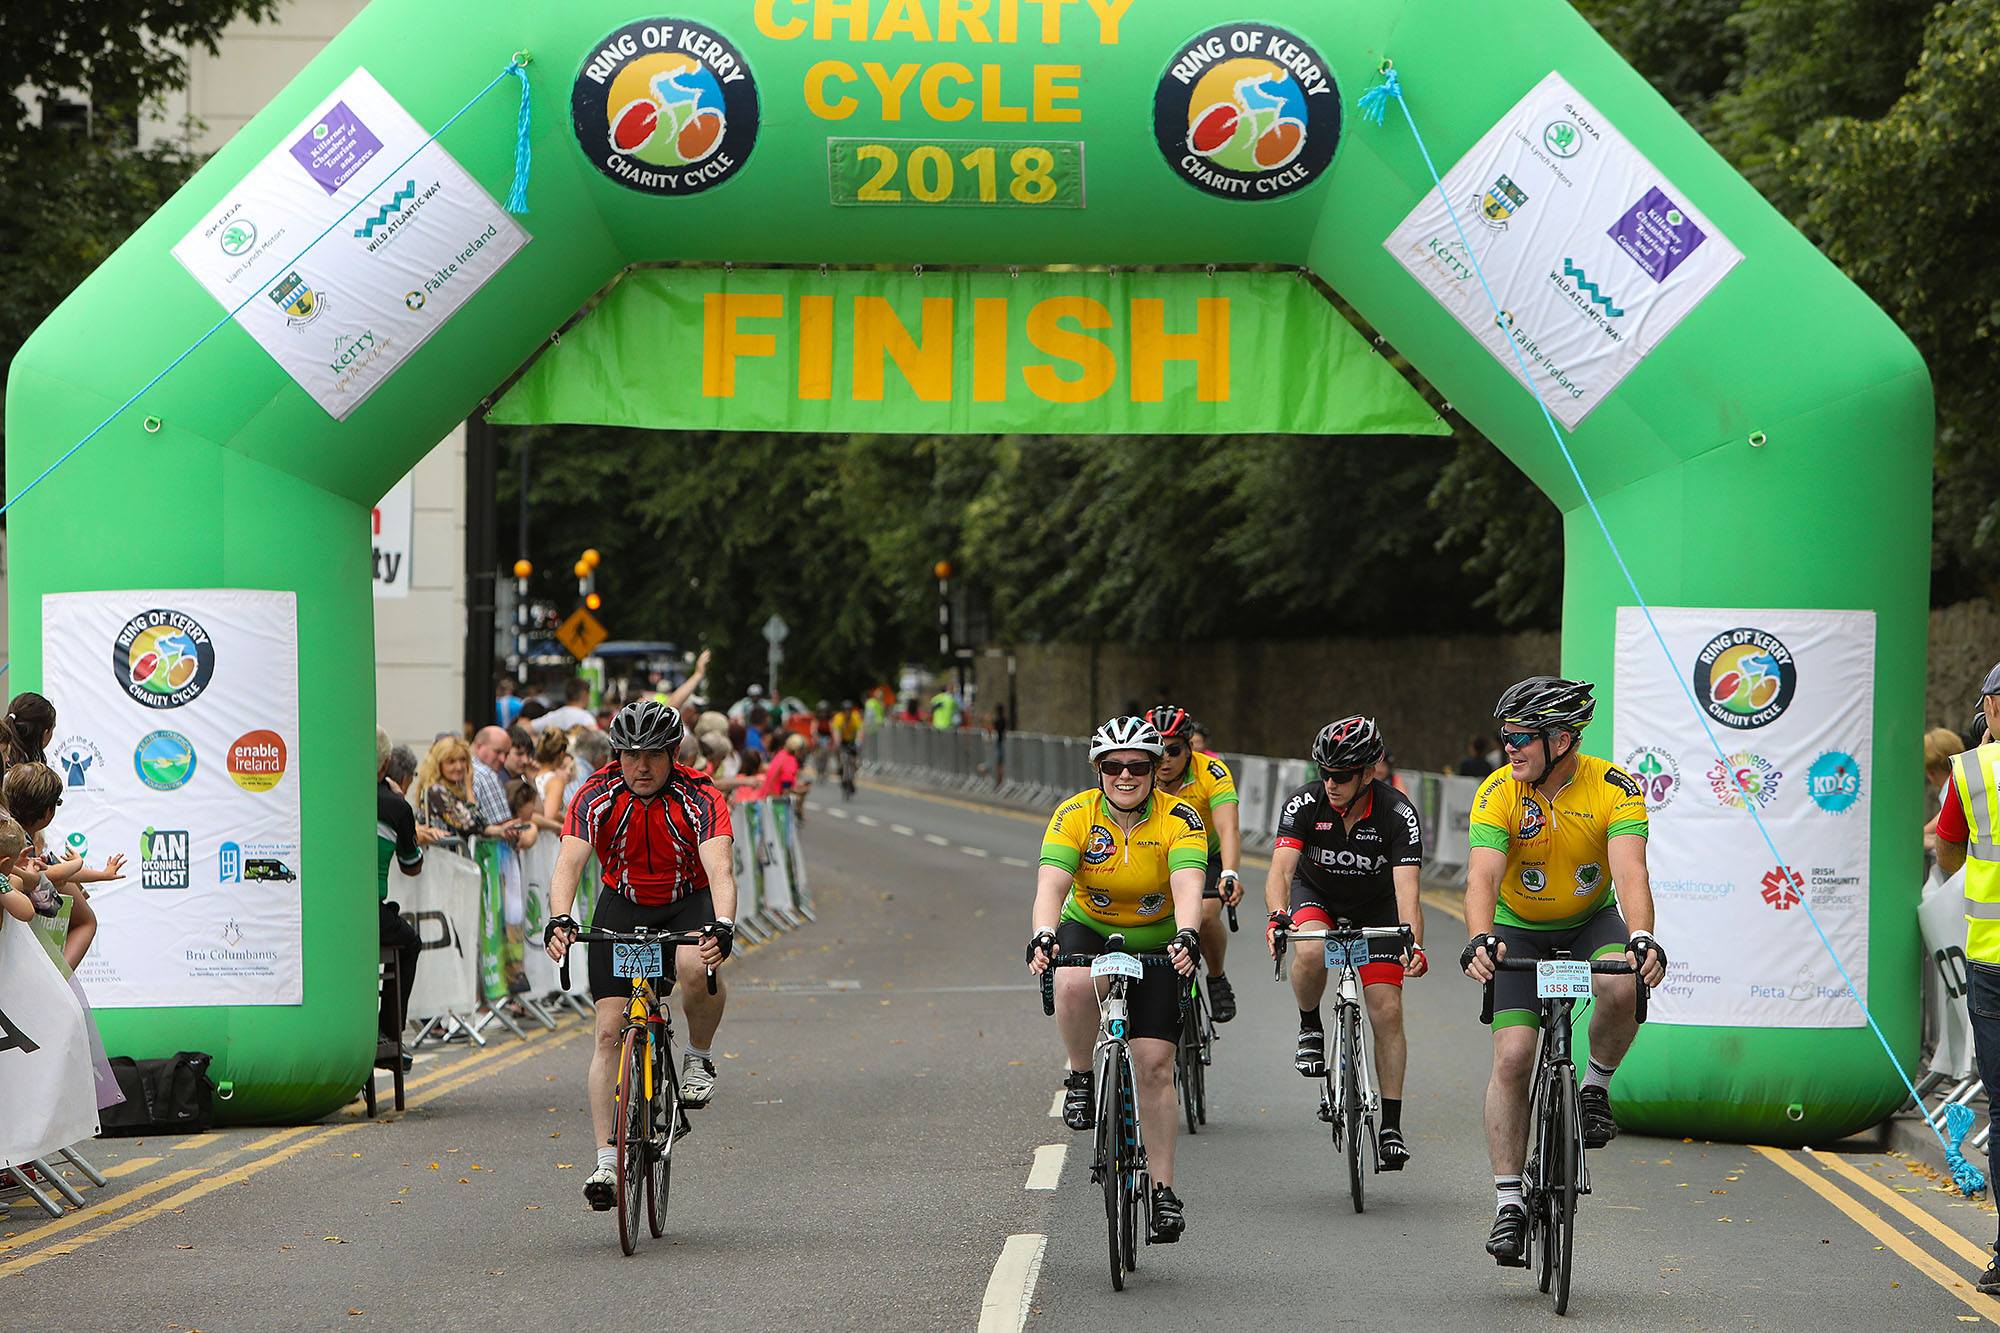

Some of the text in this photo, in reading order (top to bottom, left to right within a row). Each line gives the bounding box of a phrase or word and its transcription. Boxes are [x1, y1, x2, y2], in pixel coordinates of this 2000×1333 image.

[754, 0, 1134, 44] CHARITY
[586, 26, 745, 86] RING OF KERRY
[1171, 31, 1330, 96] RING OF KERRY
[803, 60, 1082, 123] CYCLE
[311, 124, 345, 157] Killarney
[312, 124, 356, 168] Chamber of
[324, 139, 357, 168] Tourism
[334, 149, 373, 186] Commerce
[340, 152, 355, 169] and
[606, 151, 735, 189] CHARITY CYCLE
[856, 144, 1058, 204] 2018
[1181, 155, 1309, 194] CHARITY CYCLE
[1531, 145, 1550, 166] Lynch
[1550, 164, 1573, 188] Motors
[367, 232, 388, 253] WILD
[388, 198, 425, 234] ATLANTIC
[423, 181, 441, 200] WAY
[1636, 211, 1670, 245] Chamber
[1647, 208, 1681, 244] Killarney
[225, 228, 286, 284] Liam Lynch Motors
[455, 224, 497, 265] Ireland
[1617, 235, 1656, 273] Commerce
[1635, 240, 1652, 256] and
[1550, 270, 1571, 292] WILD
[1569, 291, 1607, 328] ATLANTIC
[1605, 325, 1623, 343] WAY
[702, 292, 1230, 403] FINISH
[1543, 359, 1584, 399] Ireland
[119, 612, 209, 646] RING OF KERRY
[1700, 631, 1792, 665] RING OF KERRY
[128, 682, 200, 706] CHARITY CYCLE
[1709, 703, 1781, 726] CHARITY CYCLE
[67, 735, 75, 743] of
[76, 735, 88, 744] the
[88, 741, 105, 768] Angels
[235, 743, 279, 757] enable
[235, 757, 280, 771] ireland
[1651, 746, 1681, 792] ASSOCIATION
[142, 860, 187, 870] O'CONNELL
[1321, 848, 1388, 871] BORA
[1811, 867, 1835, 876] IRISH
[143, 870, 187, 886] TRUST
[1811, 877, 1859, 886] COMMUNITY
[210, 949, 278, 960] Columbanus
[1667, 960, 1689, 970] own
[1544, 983, 1569, 993] 1358
[1662, 983, 1694, 999] Kerry
[1666, 970, 1721, 986] Syndrome
[1750, 984, 1854, 998] Pieta House
